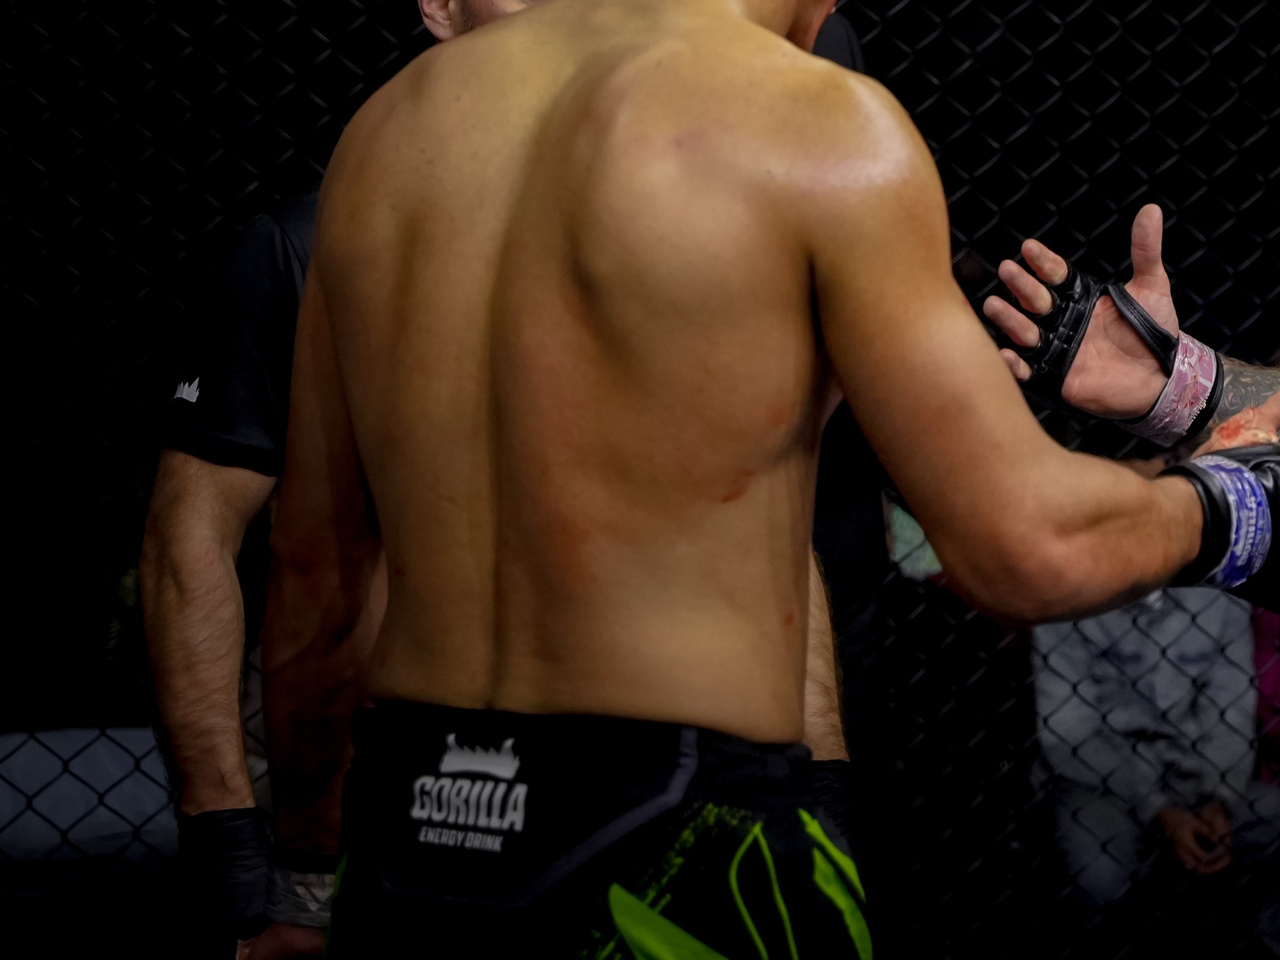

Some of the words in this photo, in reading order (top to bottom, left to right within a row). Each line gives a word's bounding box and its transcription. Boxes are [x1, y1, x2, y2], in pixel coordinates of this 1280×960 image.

[409, 775, 528, 833] GORILLA
[418, 825, 465, 847] ENERGY
[463, 831, 503, 853] DRINK
